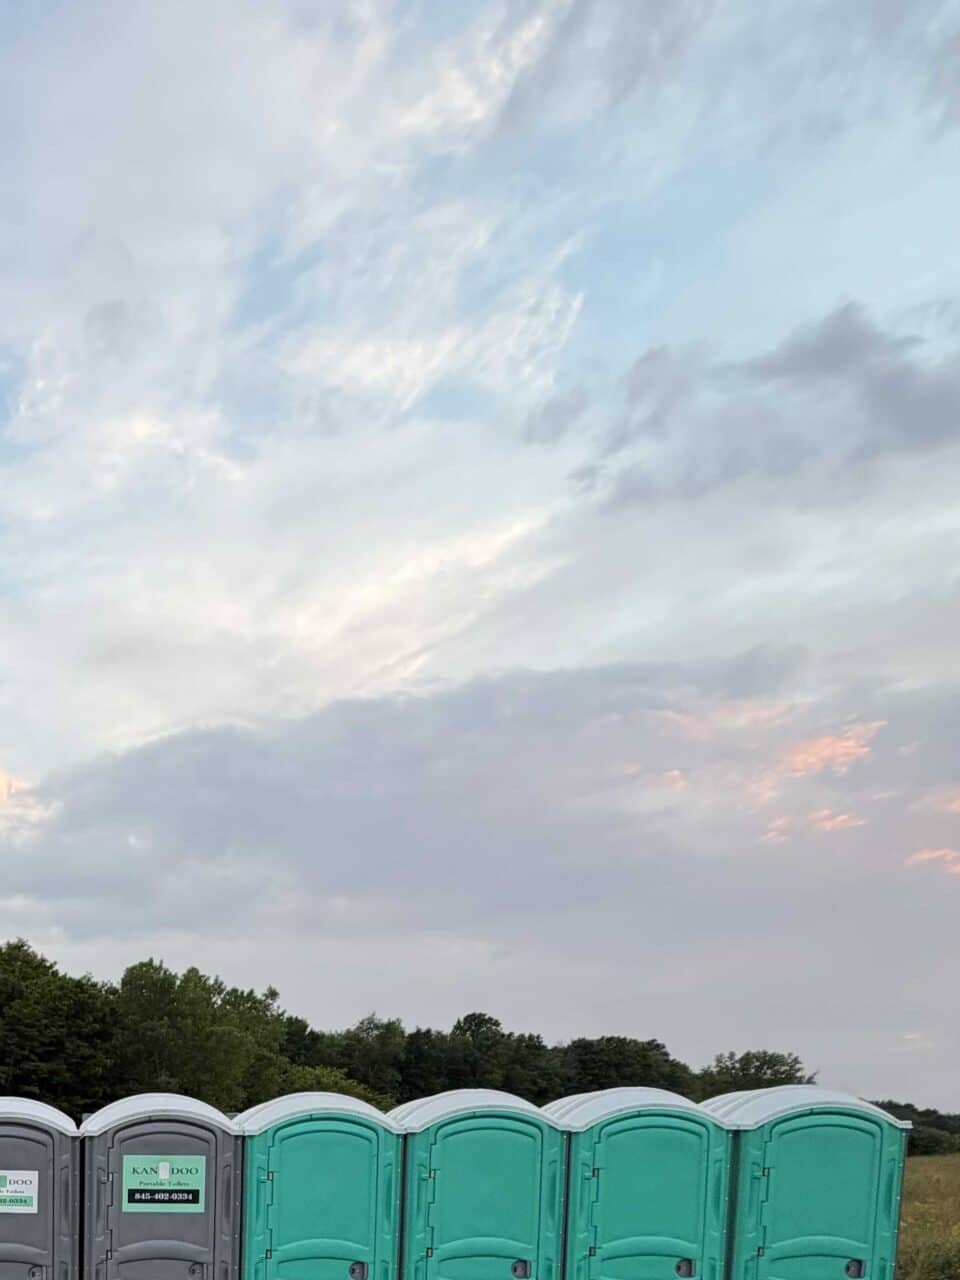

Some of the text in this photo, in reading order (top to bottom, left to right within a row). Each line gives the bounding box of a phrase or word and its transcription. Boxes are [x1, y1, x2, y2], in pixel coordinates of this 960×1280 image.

[132, 1167, 199, 1175] KAN DOO
[134, 1192, 193, 1200] 845-402-0334
